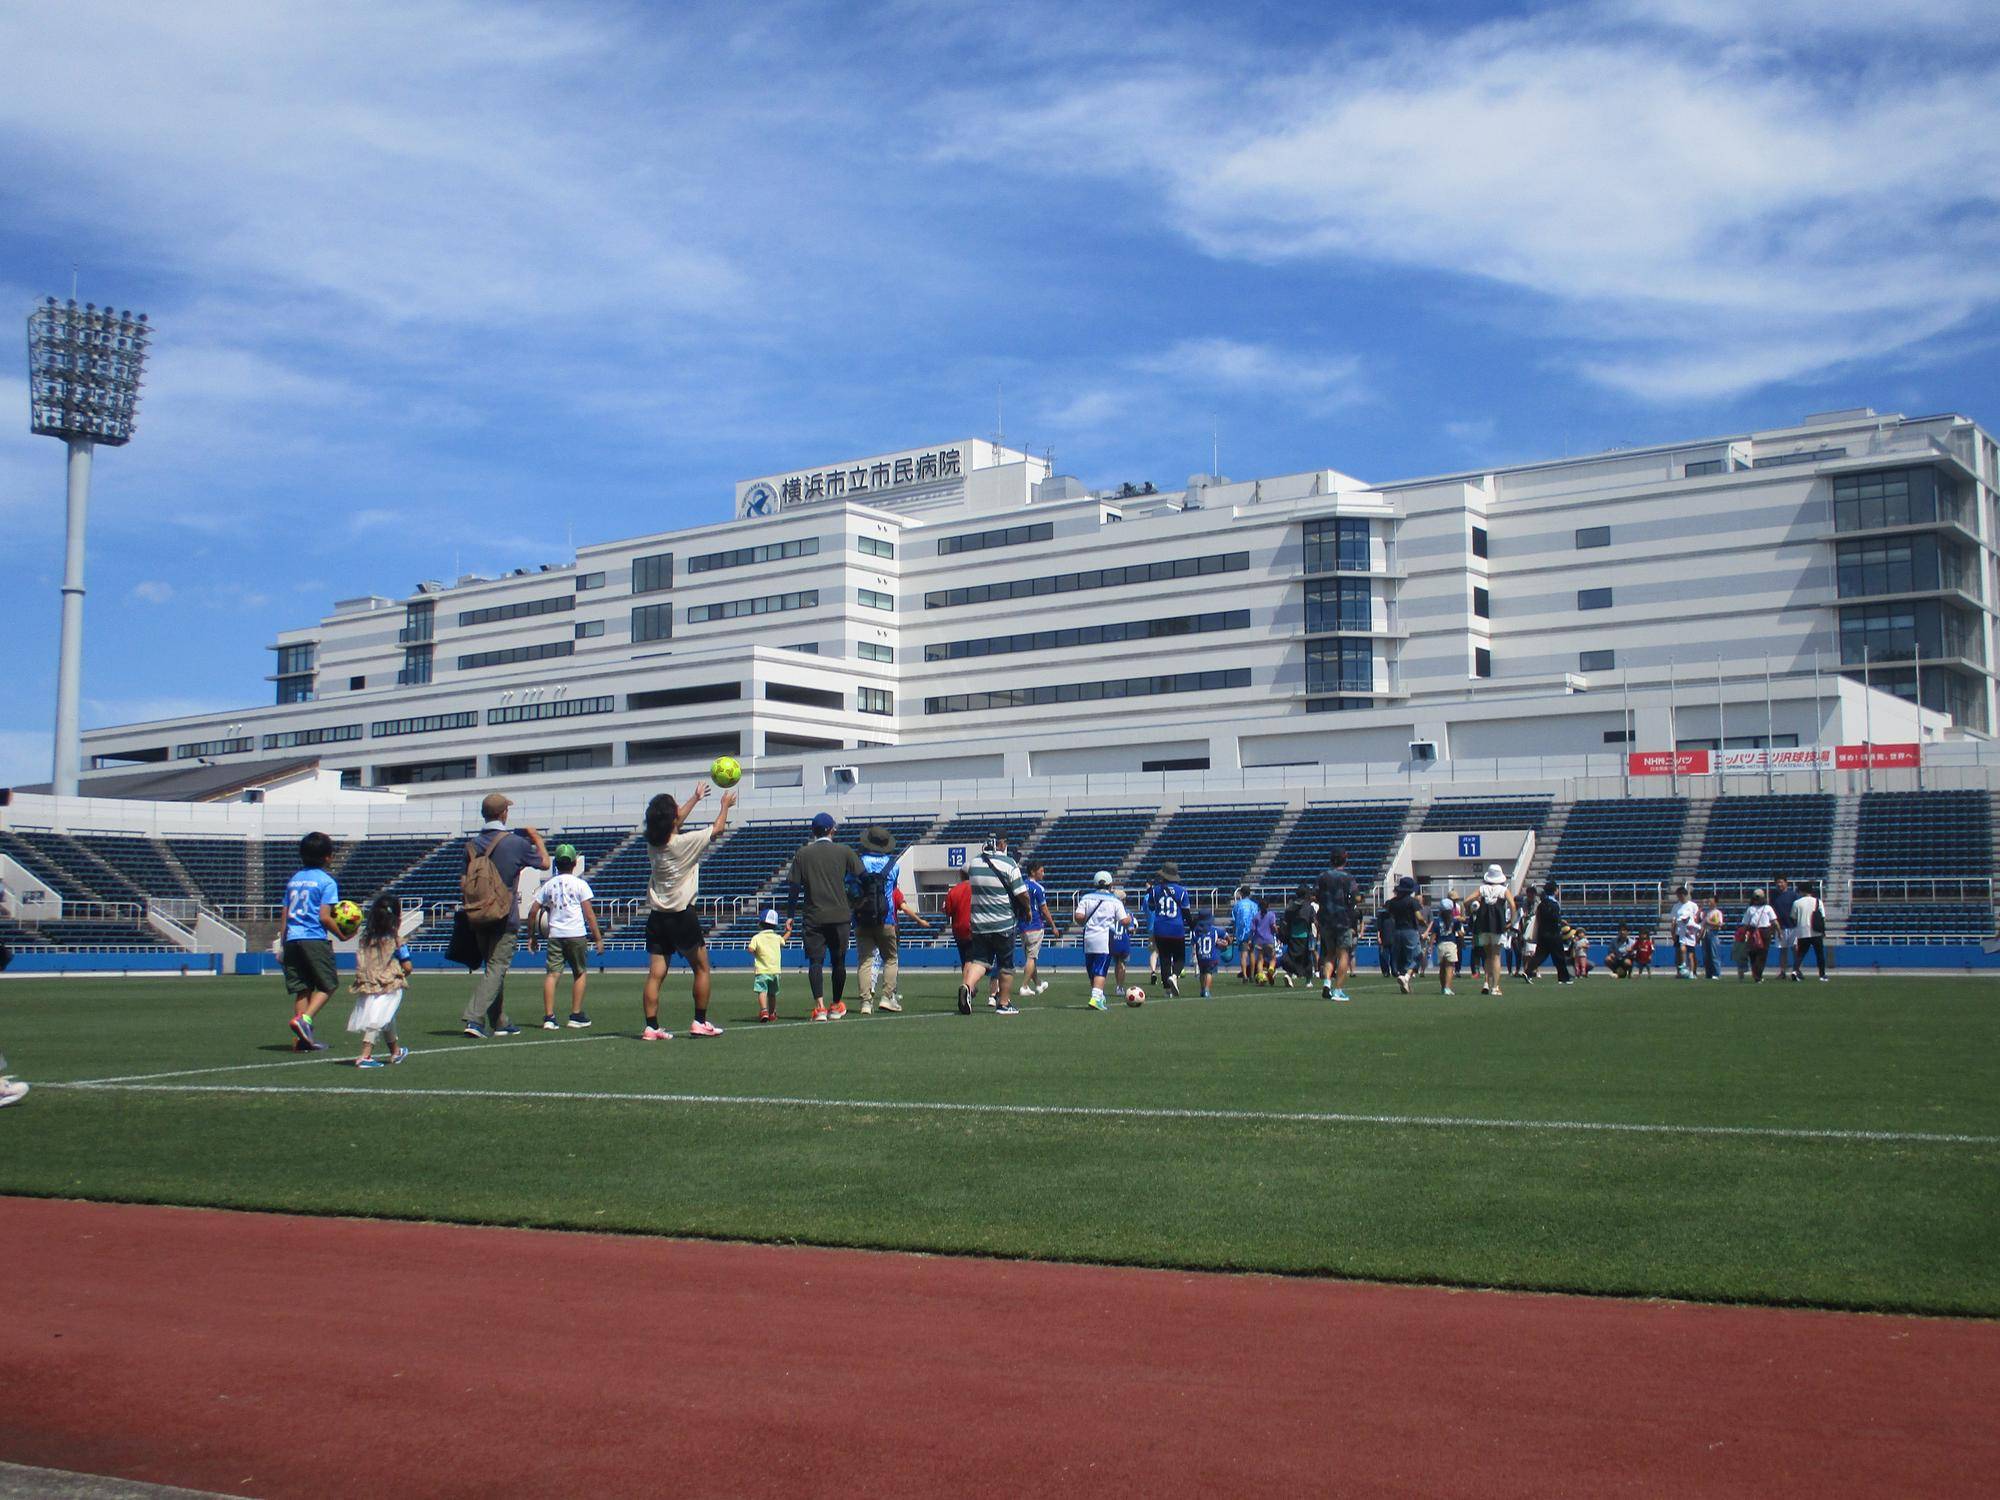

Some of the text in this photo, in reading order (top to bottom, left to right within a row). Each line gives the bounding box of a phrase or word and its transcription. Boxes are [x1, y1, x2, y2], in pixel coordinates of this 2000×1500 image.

[782, 448, 961, 504] 横浜市立市民病院
[1463, 843, 1476, 855] 11
[951, 855, 963, 865] 12
[288, 889, 309, 918] 23
[1158, 895, 1179, 918] 10
[1197, 936, 1213, 955] 10
